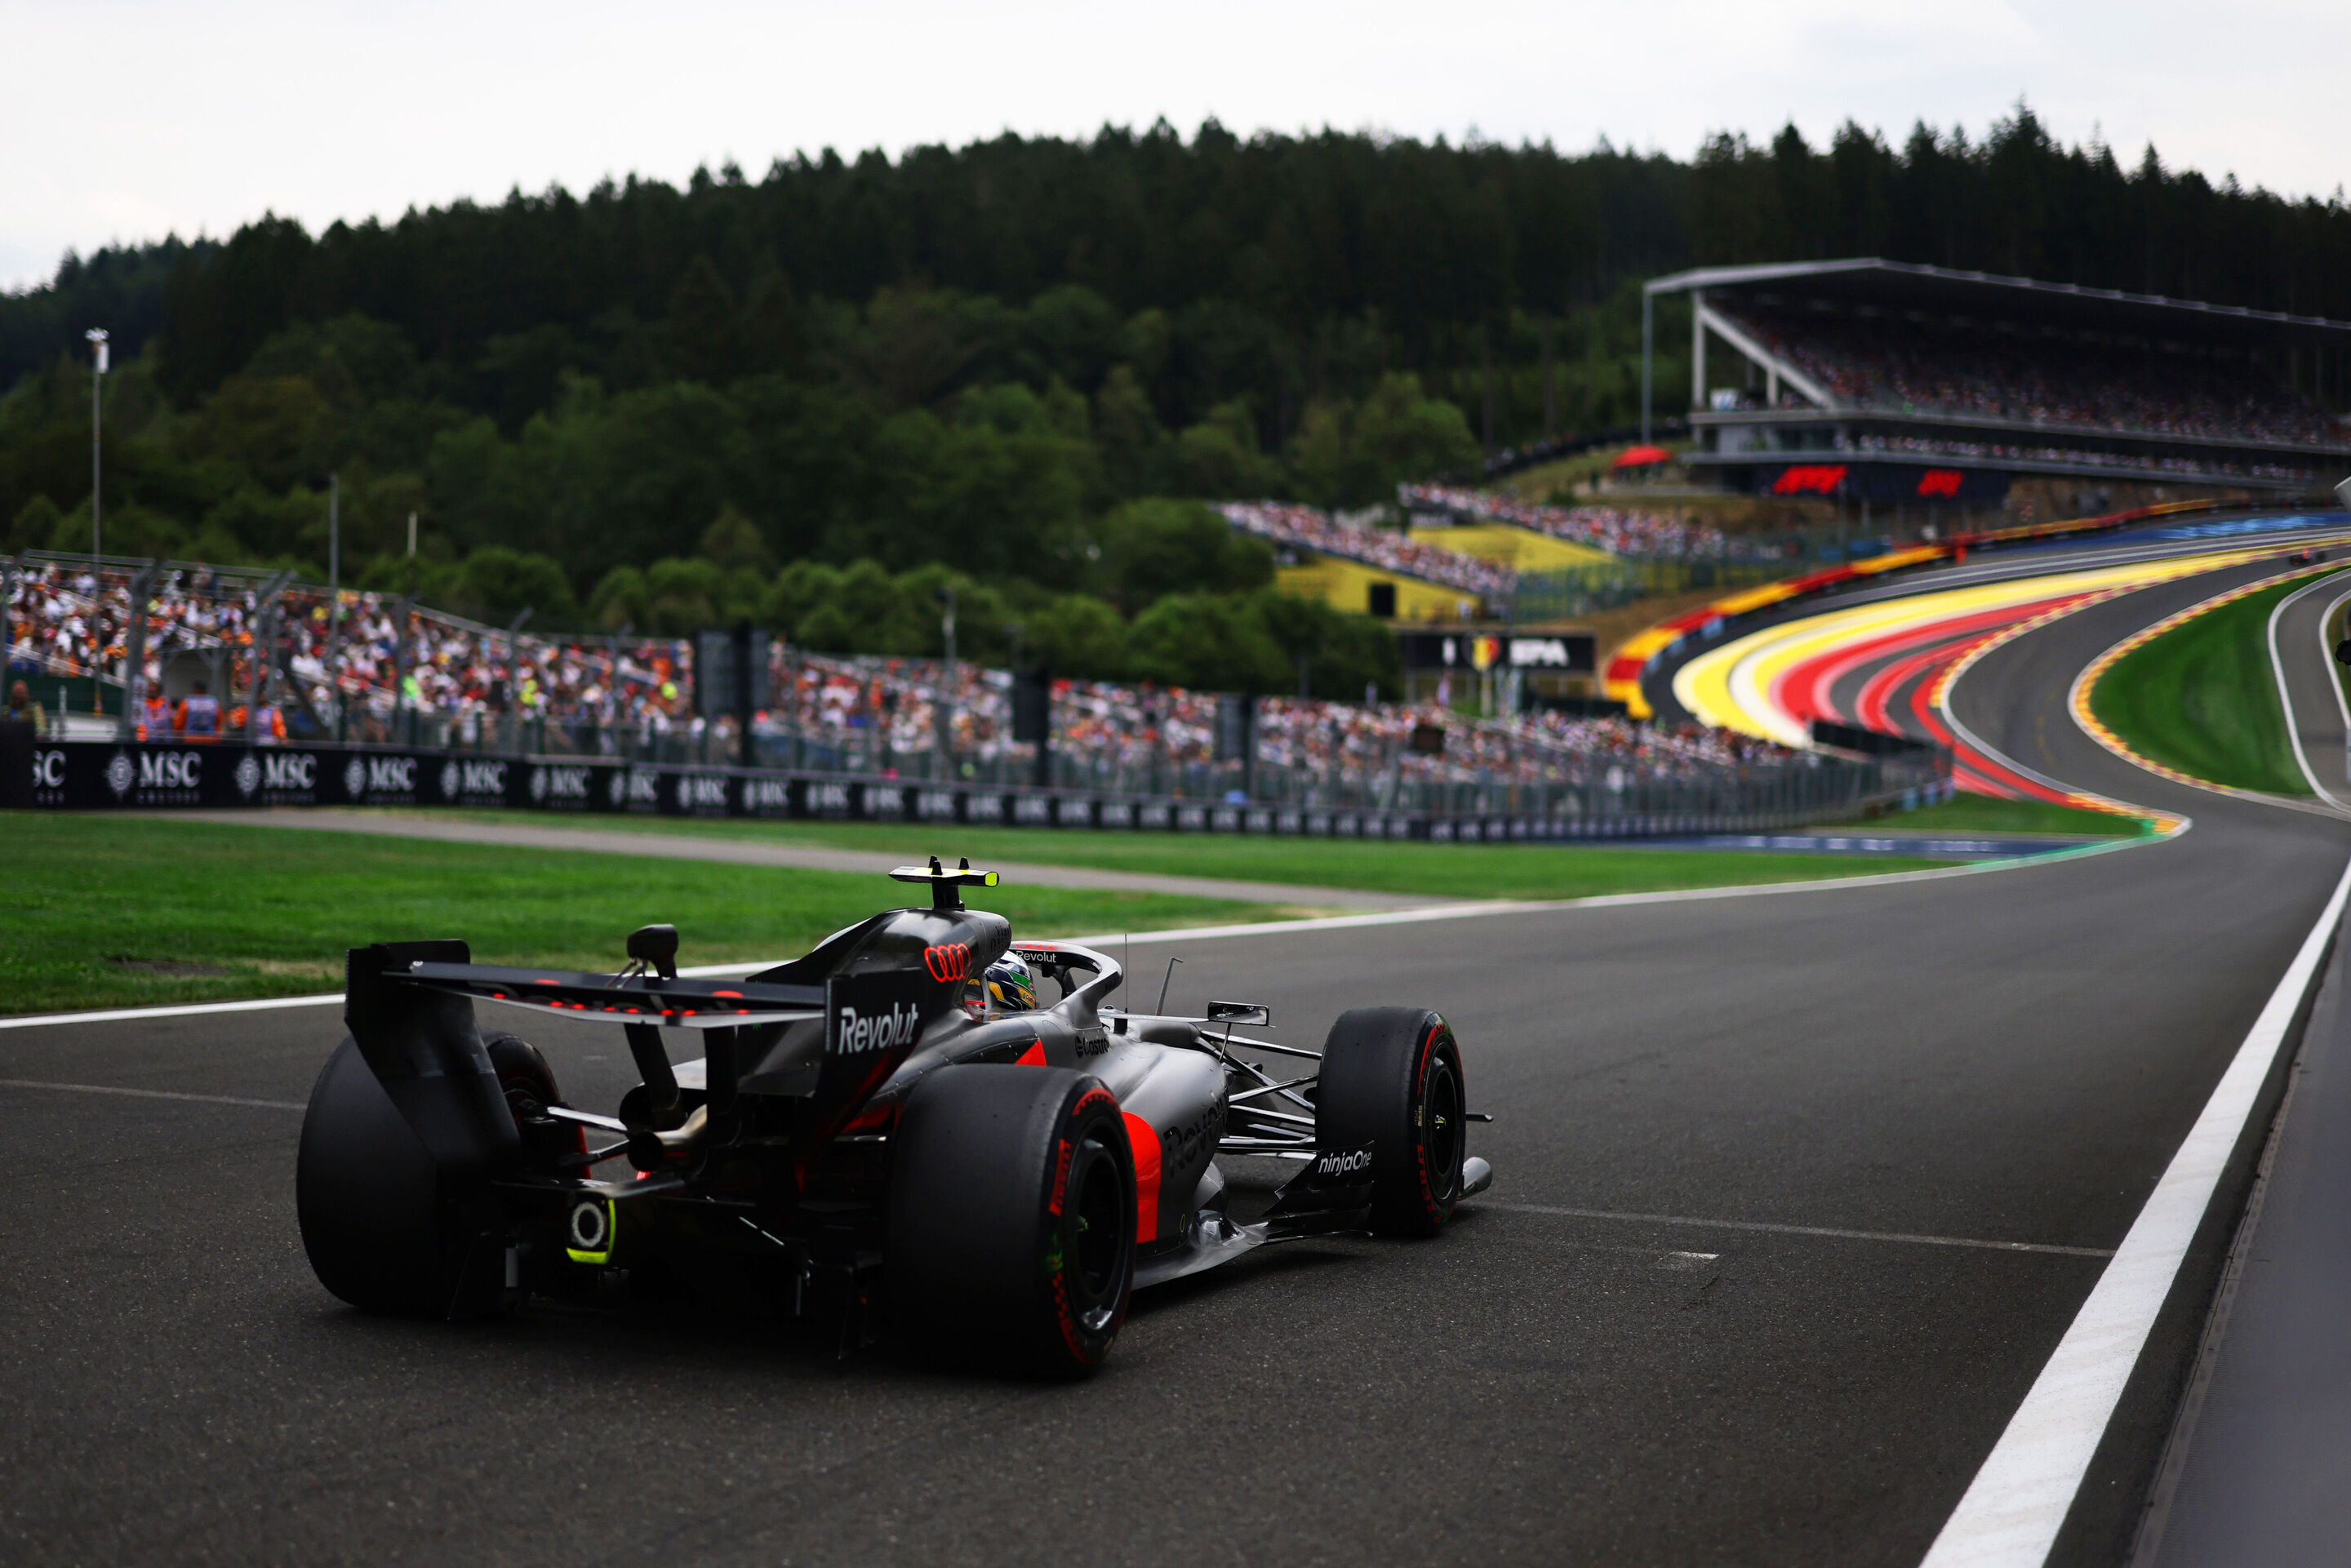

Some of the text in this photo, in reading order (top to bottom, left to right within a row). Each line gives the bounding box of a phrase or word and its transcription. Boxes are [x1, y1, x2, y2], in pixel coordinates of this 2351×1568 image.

[33, 749, 67, 788] SC
[139, 750, 202, 788] MSC
[264, 753, 318, 790] MSC
[369, 755, 418, 792] MSC
[1016, 950, 1057, 963] Revolut
[838, 1002, 918, 1055] Revolut
[1082, 1037, 1110, 1056] Castro
[1318, 1150, 1372, 1177] ninjaOne
